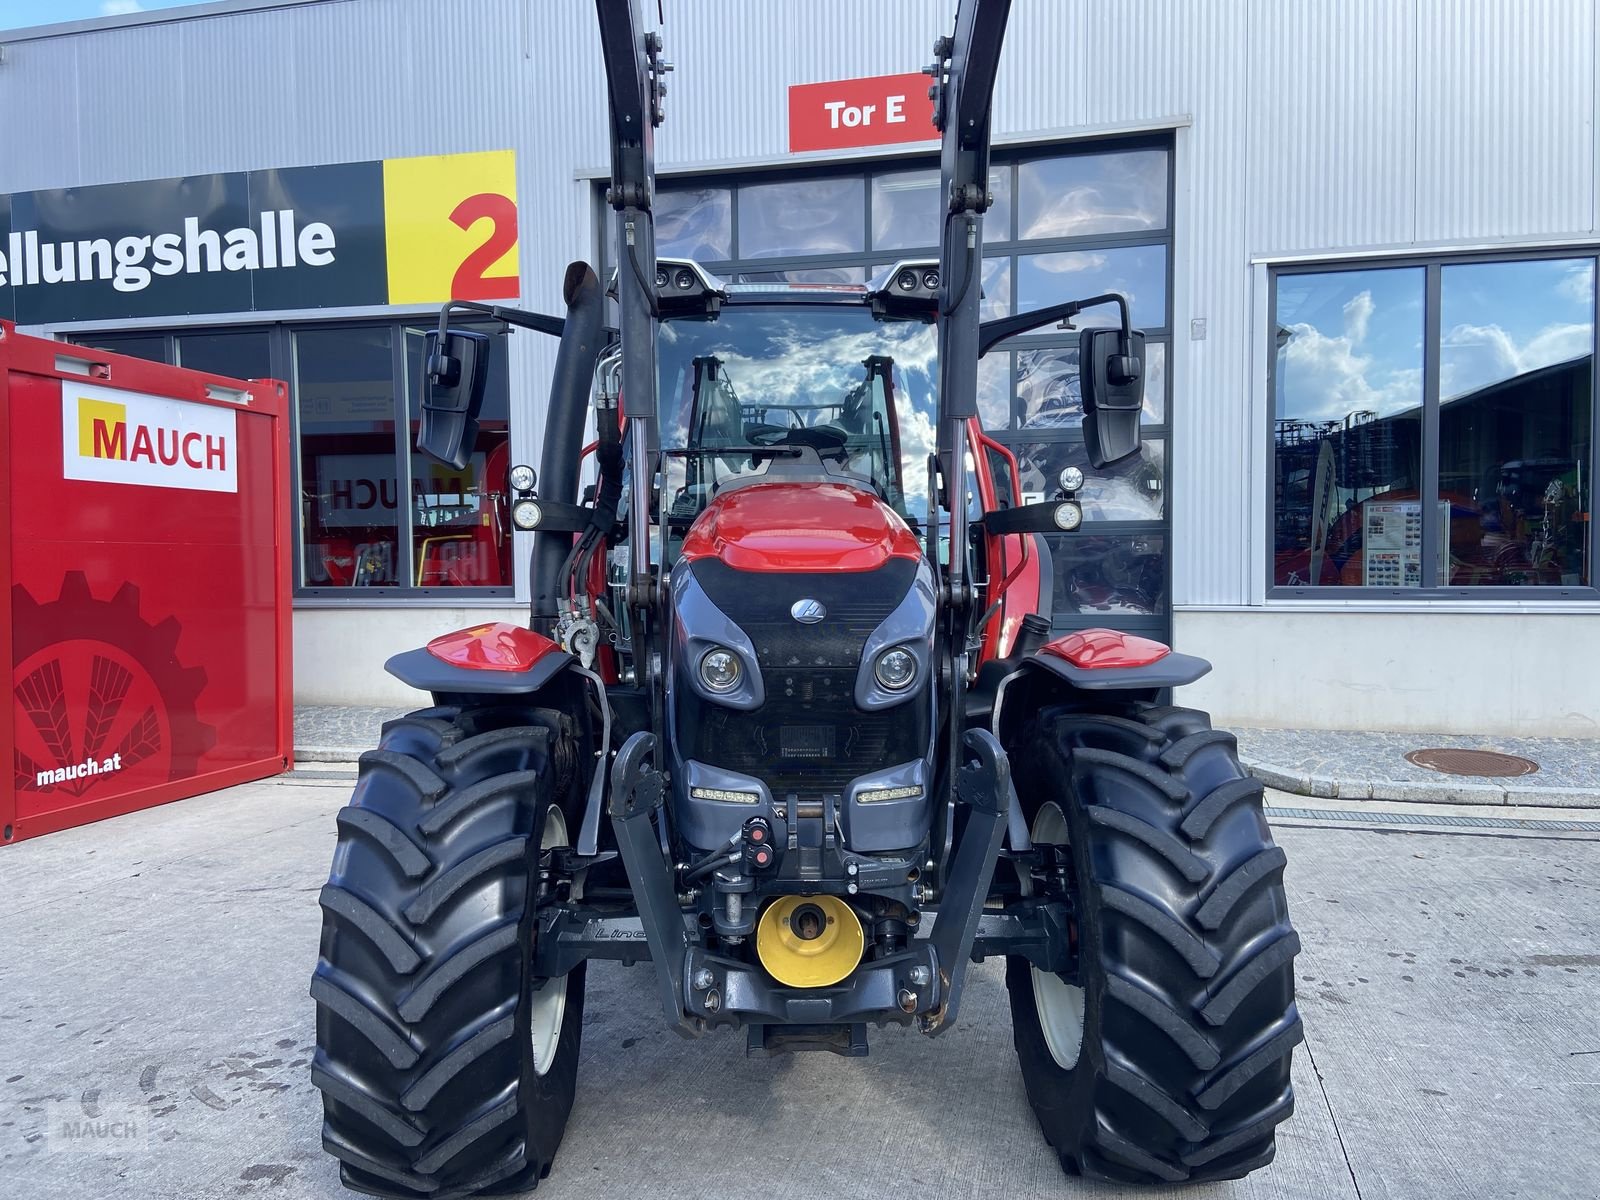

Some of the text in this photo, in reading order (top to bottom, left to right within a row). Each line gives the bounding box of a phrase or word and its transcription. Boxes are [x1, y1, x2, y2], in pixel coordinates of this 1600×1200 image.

[825, 95, 906, 129] Tor E
[0, 193, 520, 301] llungshalle 2
[92, 418, 227, 472] MAUCH
[37, 752, 122, 787] mauch.at
